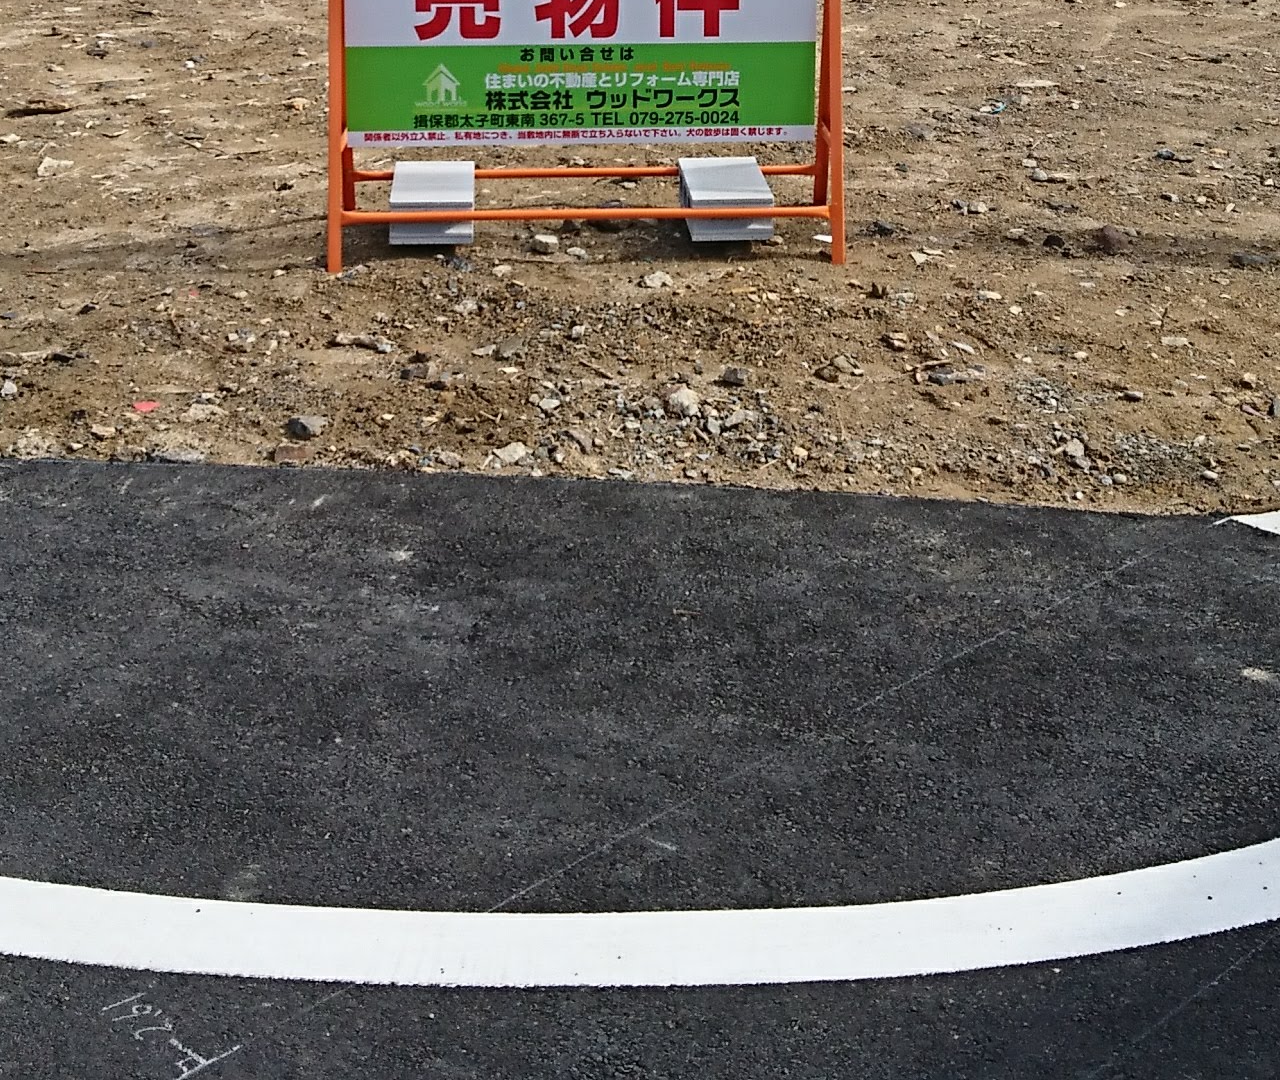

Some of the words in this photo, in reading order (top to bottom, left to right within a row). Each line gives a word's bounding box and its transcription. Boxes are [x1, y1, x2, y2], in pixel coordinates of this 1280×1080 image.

[520, 47, 635, 62] お問い合せは
[485, 71, 739, 88] 住まいの不動産とリフォーム専門店
[484, 88, 575, 111] 株式会社
[586, 88, 740, 108] ウッドワークス
[413, 112, 537, 129] 揖保郡太子町東南
[539, 112, 586, 127] 367-5
[590, 111, 625, 126] TEL
[628, 110, 741, 126] 079-275-0024
